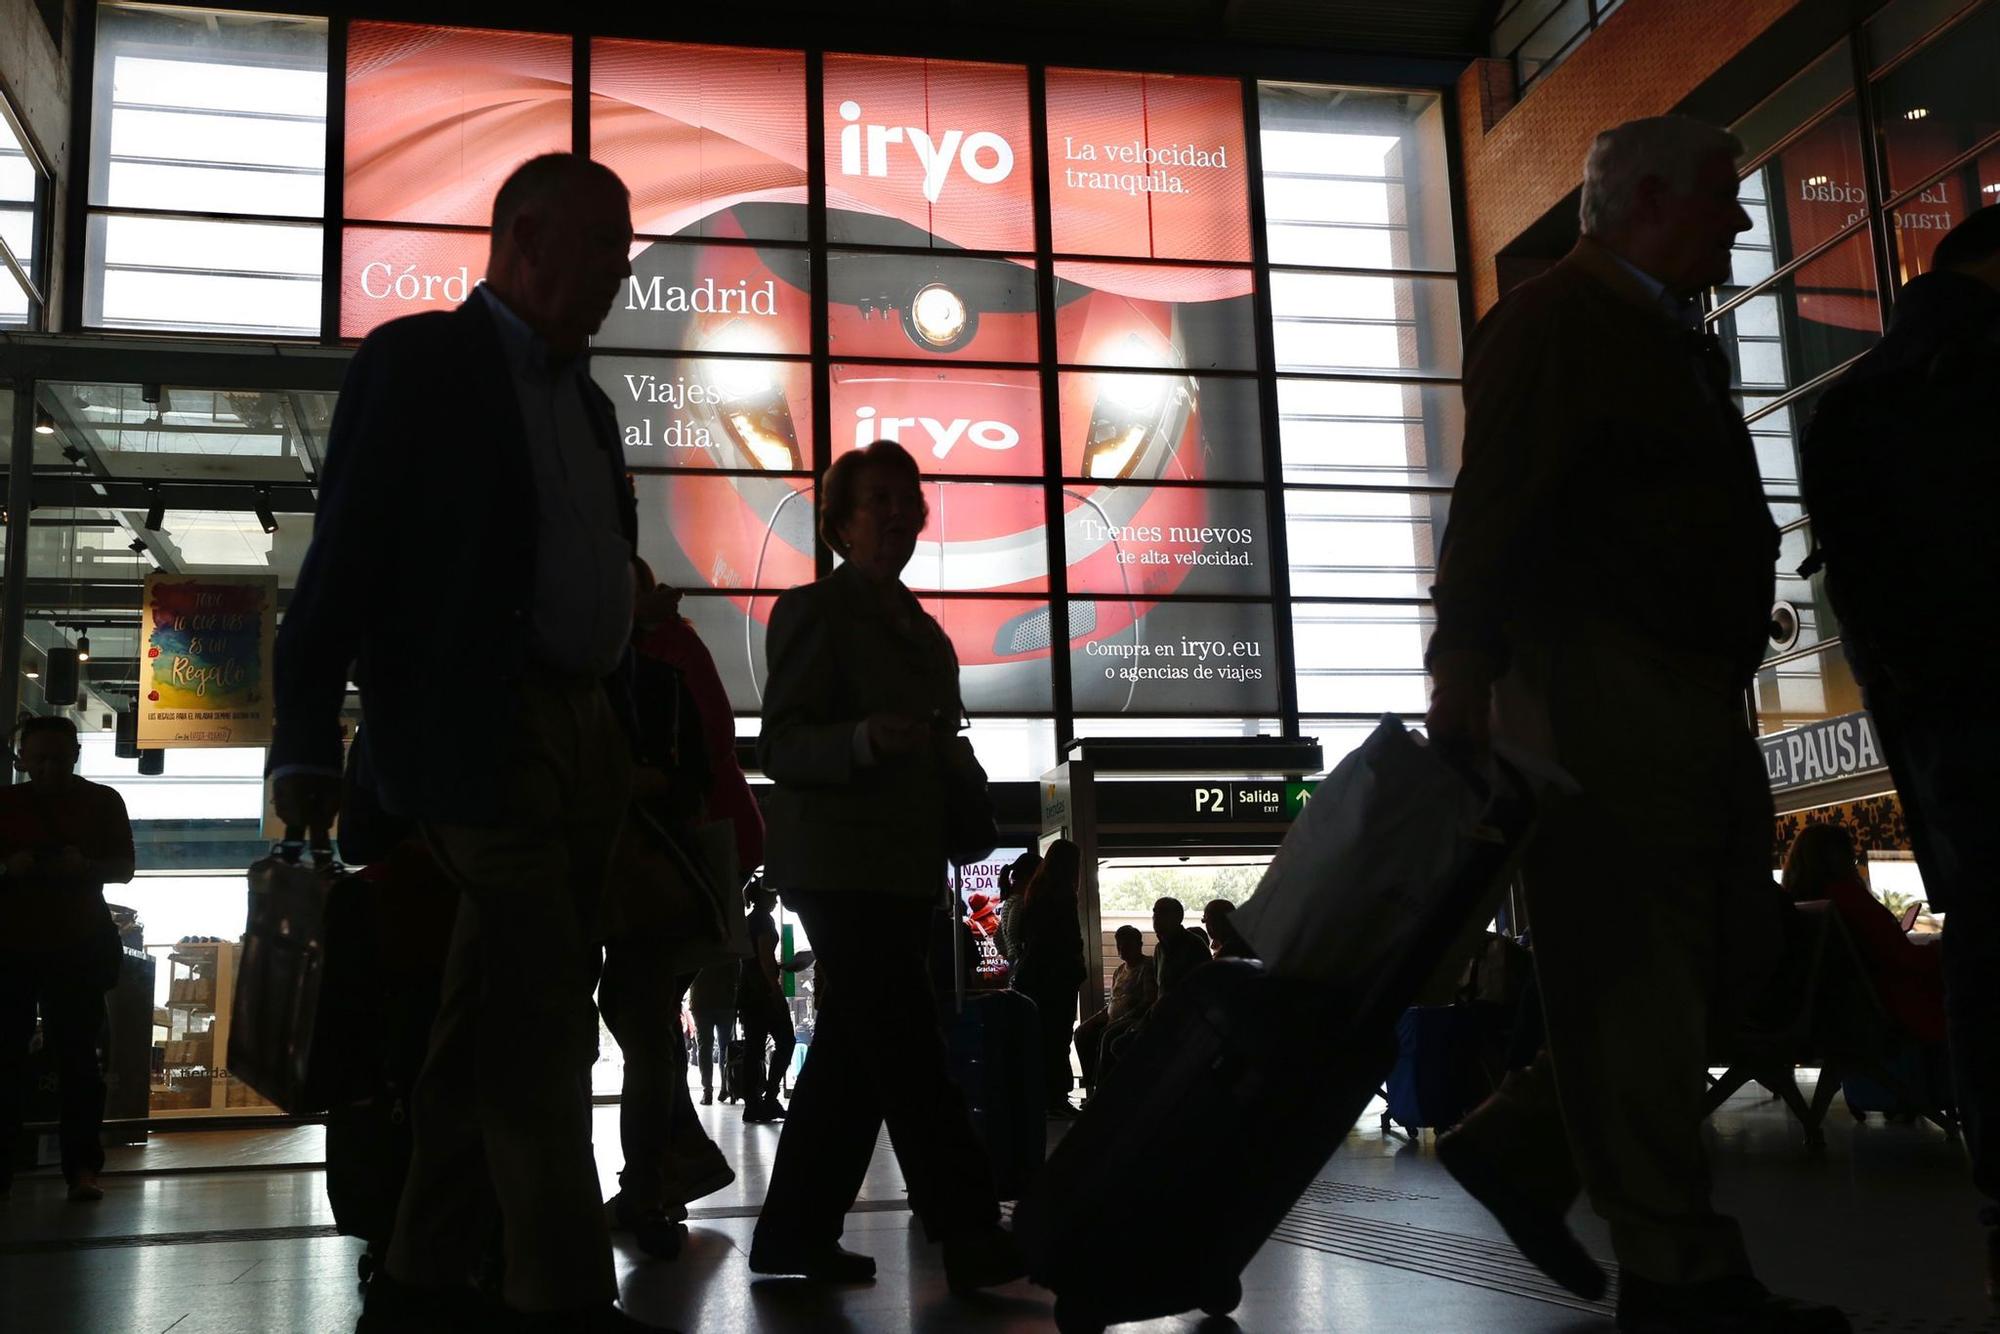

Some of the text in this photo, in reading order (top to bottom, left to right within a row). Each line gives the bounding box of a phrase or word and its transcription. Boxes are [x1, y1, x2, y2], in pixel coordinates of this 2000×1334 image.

[839, 100, 1014, 204] iryo
[1064, 136, 1228, 169] La velocidad
[1065, 167, 1190, 196] tranquila.
[361, 261, 778, 316] Córd Madrid
[624, 374, 721, 410] Viajes
[624, 419, 721, 448] al día.
[855, 406, 1020, 460] iryo
[1079, 519, 1253, 544] Trenes nuevos
[1116, 550, 1254, 567] de alta velocidad.
[1086, 636, 1261, 661] Compra en iryo.eu
[172, 655, 247, 697] Regalo
[1105, 664, 1263, 682] o agencias de viajes
[1764, 717, 1880, 784] LA PAUSA
[1195, 788, 1225, 812] P2
[1239, 790, 1279, 803] Salida
[1263, 805, 1279, 813] EXIT
[963, 864, 1001, 876] NADIE
[976, 877, 993, 889] DA
